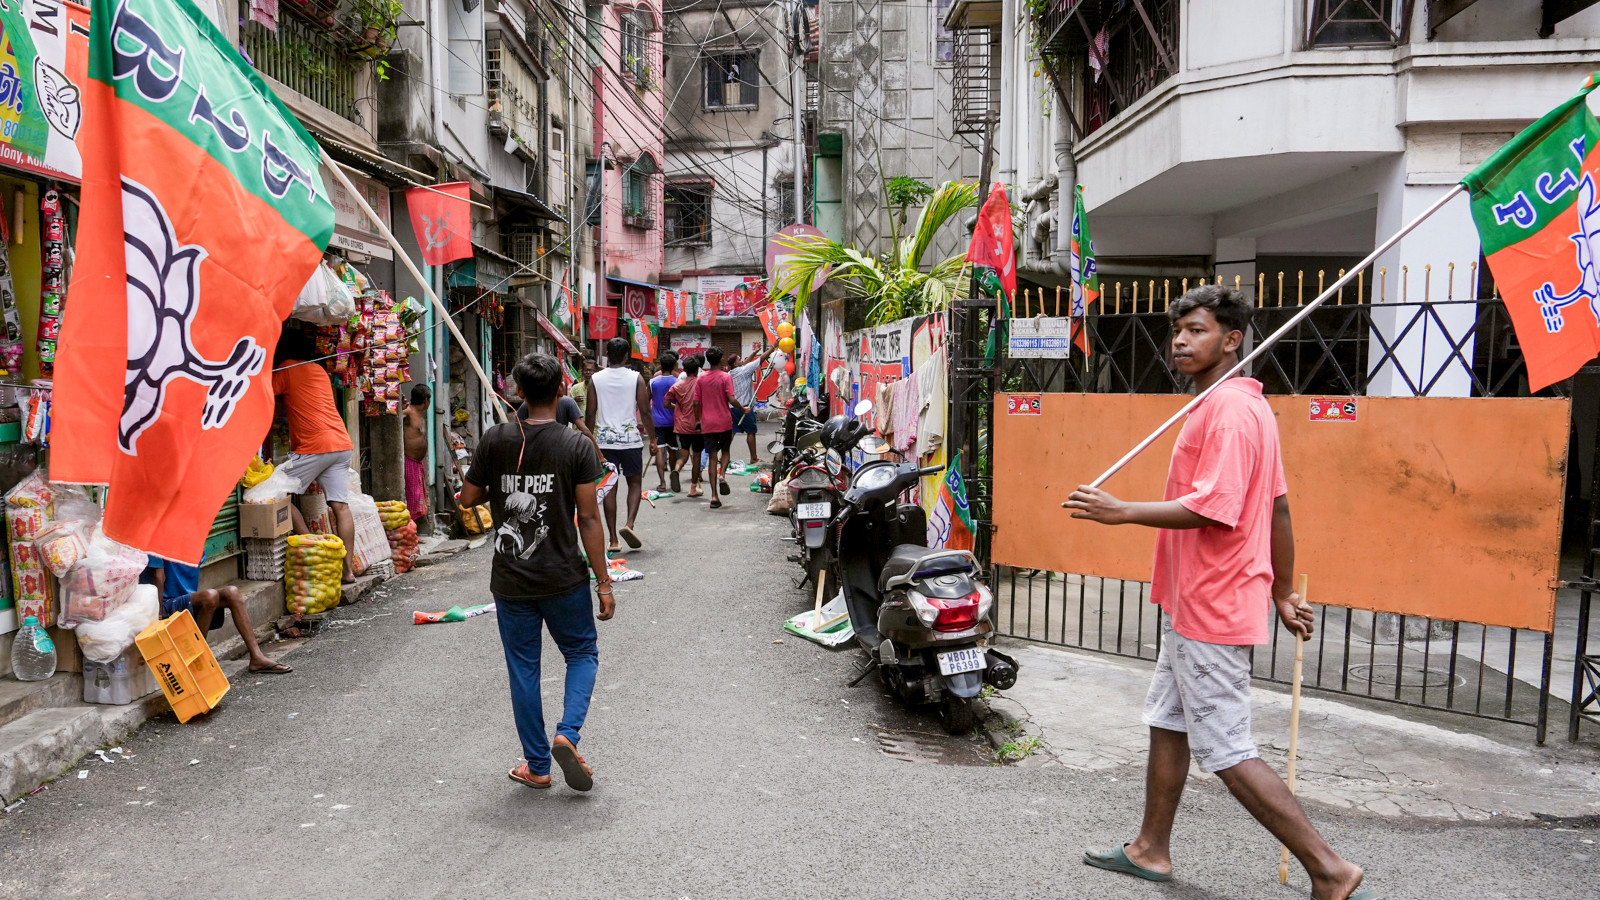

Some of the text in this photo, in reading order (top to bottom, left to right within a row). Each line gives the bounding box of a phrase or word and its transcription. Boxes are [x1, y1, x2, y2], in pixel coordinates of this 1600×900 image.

[0, 143, 24, 164] lony,
[338, 236, 364, 250] PAPPU STORES
[501, 474, 521, 493] ONE
[947, 649, 978, 663] WB01A
[949, 660, 980, 673] P6399
[159, 662, 185, 695] Amul
